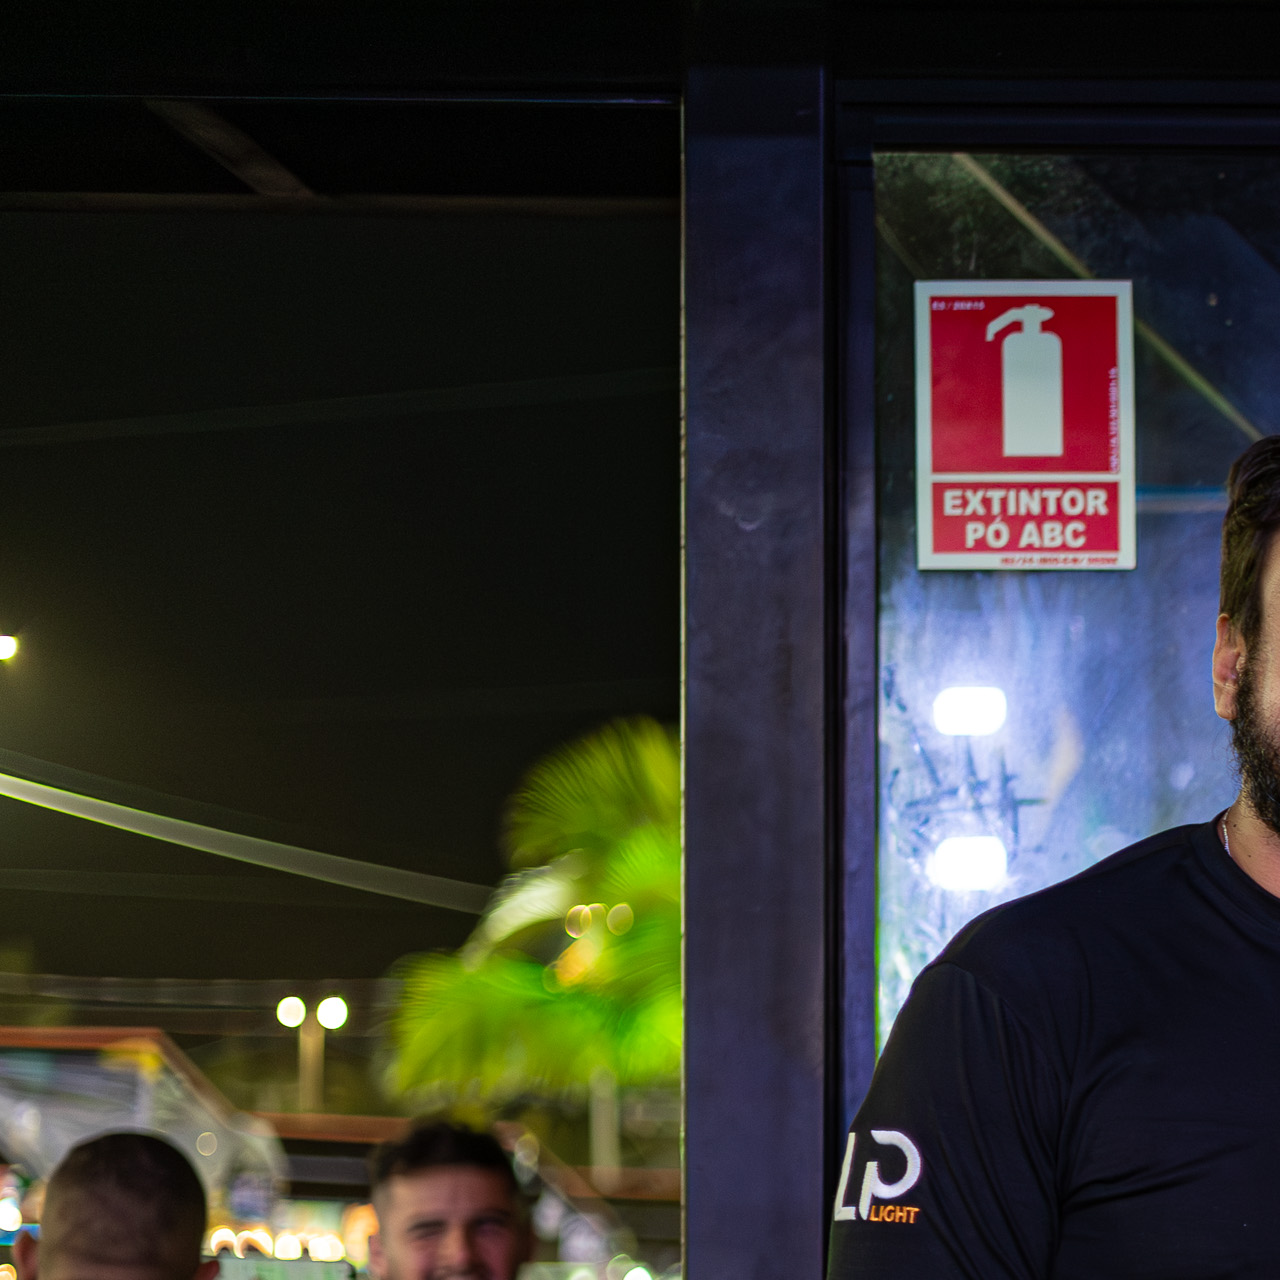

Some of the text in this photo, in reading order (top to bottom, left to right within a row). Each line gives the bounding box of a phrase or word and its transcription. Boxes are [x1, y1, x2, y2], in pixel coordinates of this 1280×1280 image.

[943, 488, 1109, 517] EXTINTOR
[965, 516, 1087, 549] PÓ ABC
[869, 1205, 920, 1224] LIGHT
